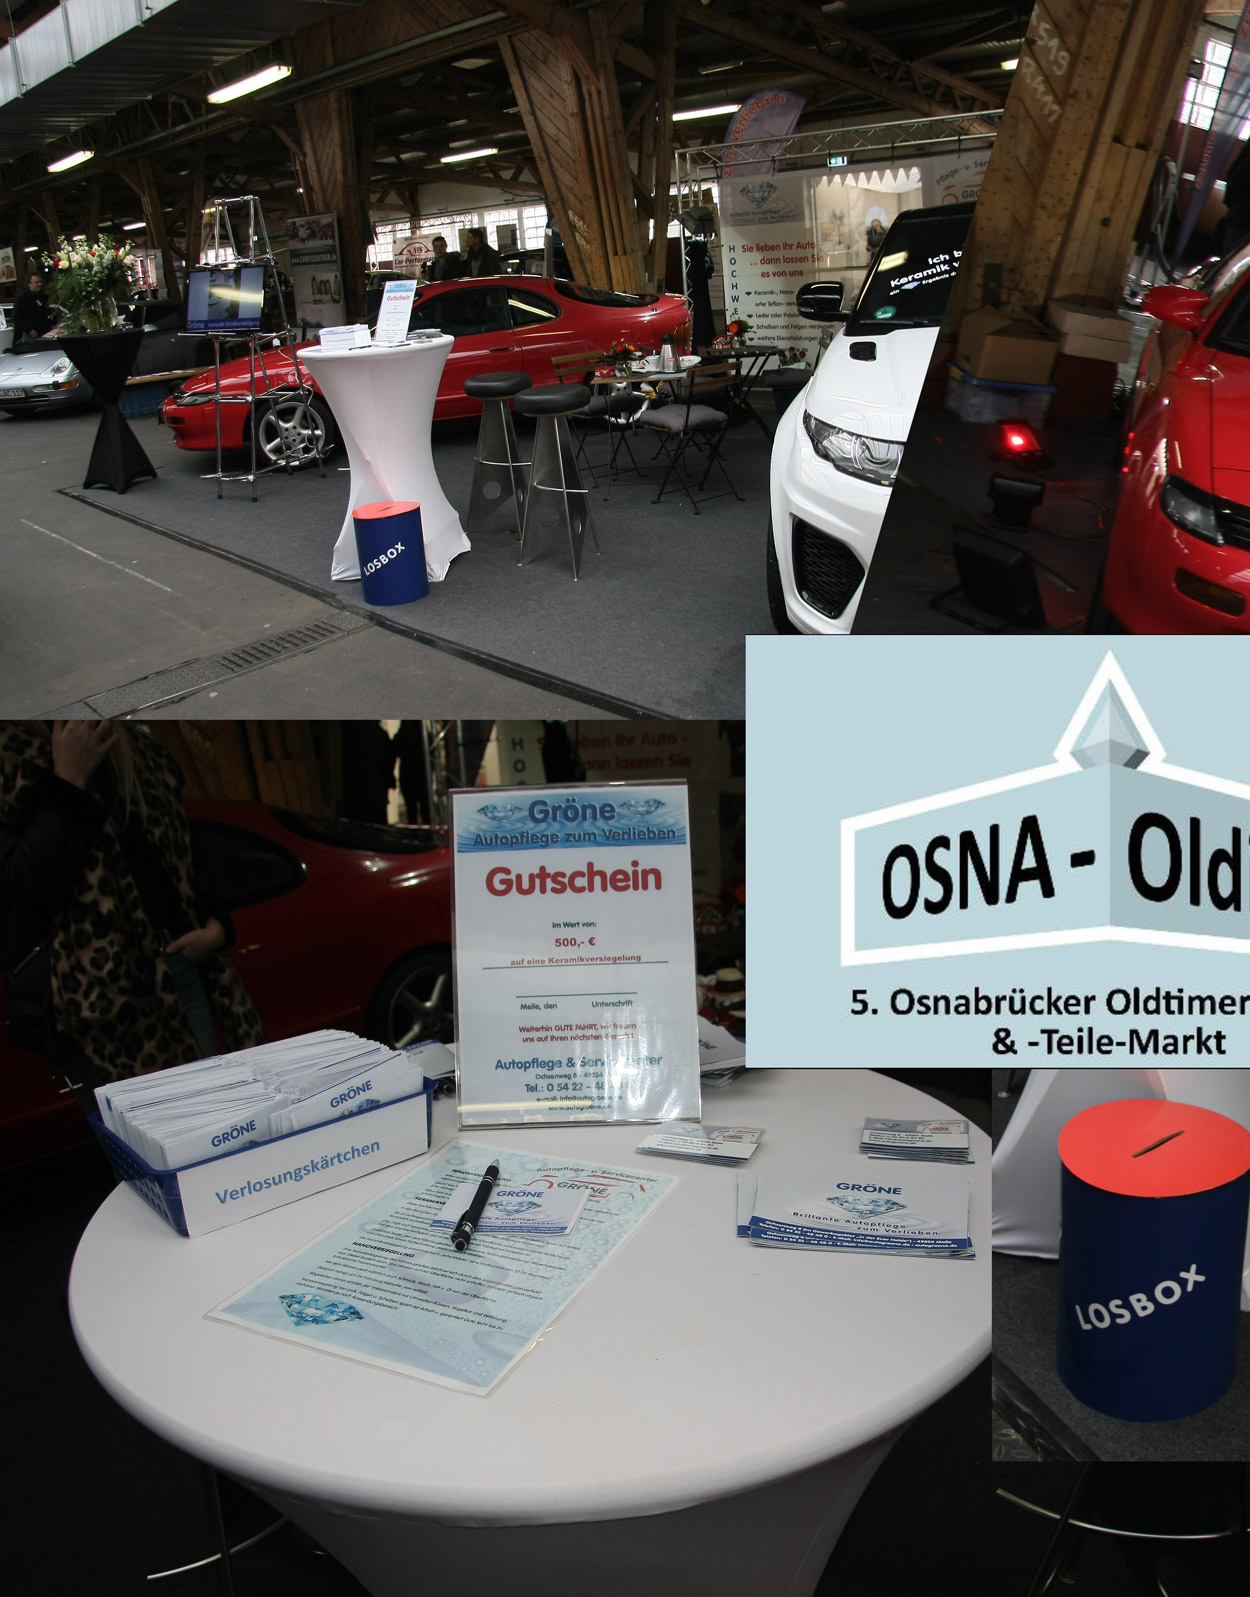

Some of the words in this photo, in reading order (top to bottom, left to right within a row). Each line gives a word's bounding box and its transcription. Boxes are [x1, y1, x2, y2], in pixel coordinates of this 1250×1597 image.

[730, 93, 786, 142] verlieben
[742, 244, 754, 252] Sie
[756, 243, 780, 252] lieben
[782, 242, 794, 251] Ihr
[796, 241, 816, 249] Auto
[760, 256, 781, 265] dann
[782, 255, 809, 264] lassen
[927, 251, 950, 265] Ich
[890, 264, 951, 288] Keramik
[386, 294, 411, 302] Gutschein
[187, 320, 205, 329] Gröne
[363, 541, 406, 576] LOSBOX
[616, 733, 636, 748] Ihr
[640, 731, 677, 746] Auto
[616, 755, 664, 769] lassen
[668, 753, 692, 768] Sie
[528, 796, 617, 824] Gröne
[474, 830, 560, 849] Autopflege
[564, 832, 597, 844] zum
[602, 826, 677, 842] Verlieben
[485, 860, 663, 897] Gutschein
[562, 920, 580, 928] Wert
[554, 937, 585, 949] 500,-
[588, 937, 596, 946] €
[510, 958, 525, 966] auf
[527, 958, 547, 966] eine
[548, 953, 642, 965] Keramikversiegelung
[520, 1003, 541, 1011] Melle,
[591, 999, 633, 1008] Unterschrift
[519, 1025, 553, 1033] Weiterhin
[555, 1024, 574, 1032] GUTE
[575, 1023, 599, 1032] FAHRT,
[536, 1035, 549, 1043] auf
[550, 1034, 569, 1042] Ihren
[570, 1033, 602, 1042] nächsten
[494, 1057, 563, 1072] Autopflege
[566, 1057, 576, 1068] &
[535, 1073, 572, 1081] Ochsenweg
[330, 1080, 373, 1109] GRÖNE
[525, 1083, 544, 1093] Tel.:
[547, 1083, 554, 1092] 0
[556, 1082, 569, 1092] 54
[571, 1082, 584, 1091] 22
[211, 1119, 257, 1148] GRÖNE
[215, 1138, 381, 1205] Verlosungskärtchen
[537, 1166, 590, 1174] Autopflege-
[601, 1169, 659, 1183] Servicecenter
[496, 1189, 545, 1198] GRÖNE
[835, 1180, 902, 1195] GRÖNE
[792, 1211, 840, 1223] Brillante
[844, 1218, 906, 1229] Autopflege
[884, 1228, 938, 1236] Verlieben
[351, 1241, 416, 1259] NANOVERSIEGELUNG
[1074, 1263, 1206, 1331] LOSBOX
